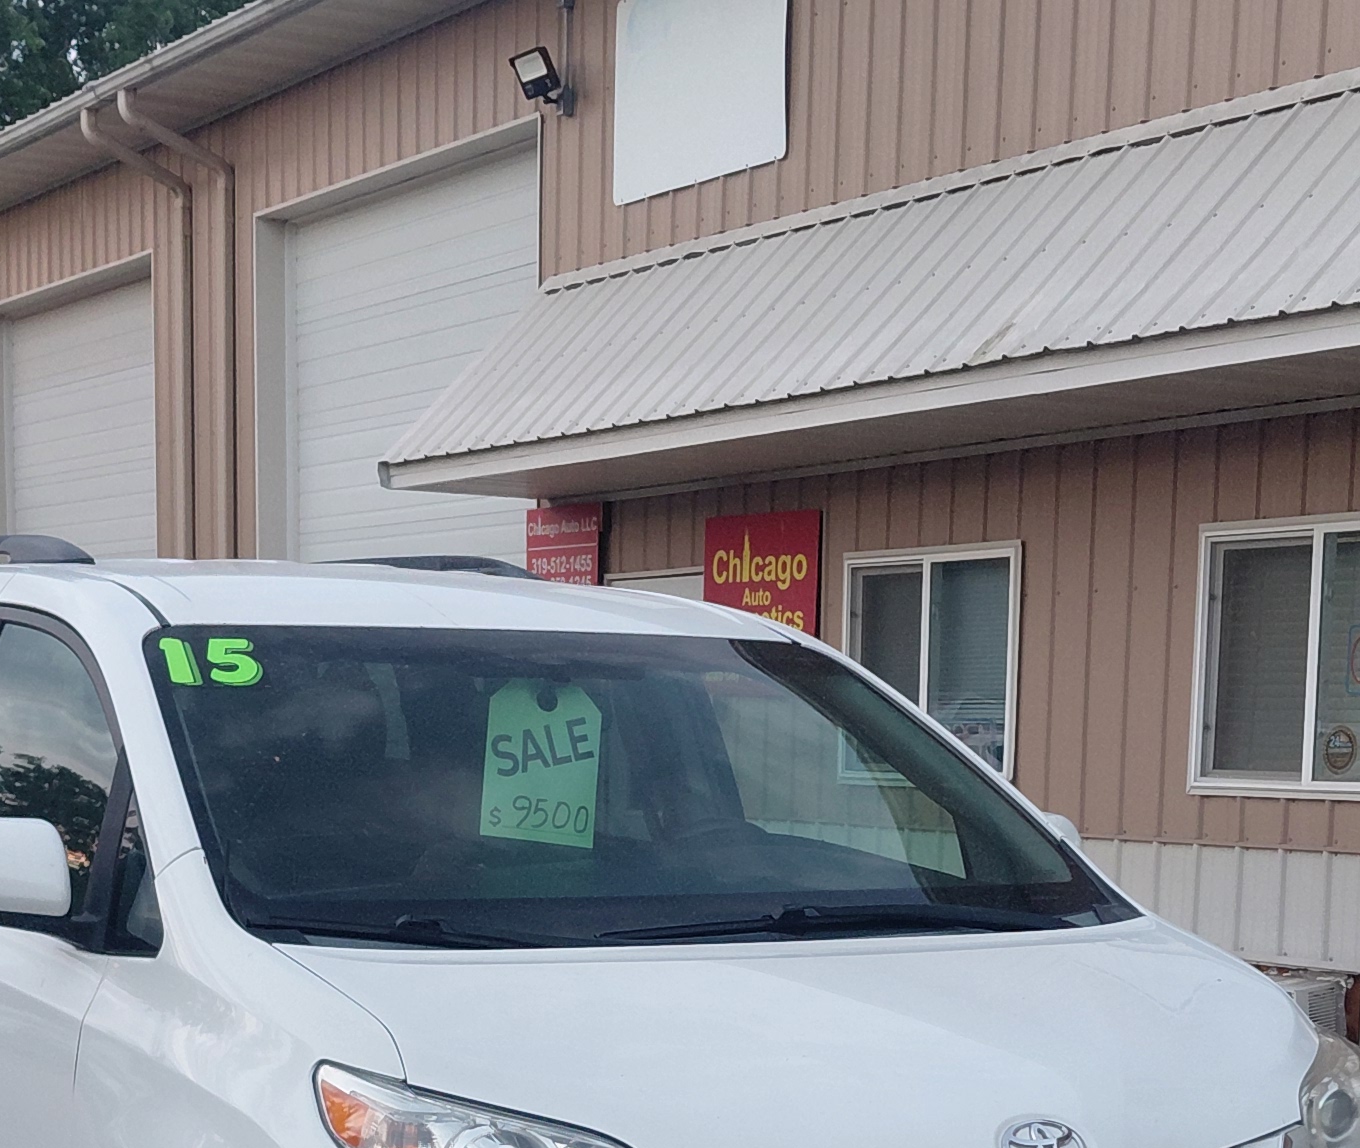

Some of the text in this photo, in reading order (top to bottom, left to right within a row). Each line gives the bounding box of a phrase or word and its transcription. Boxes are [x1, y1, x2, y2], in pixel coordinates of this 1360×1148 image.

[527, 515, 597, 538] Chicago Auto LLC
[531, 554, 593, 575] 319-512-1455
[712, 526, 808, 590] Chicago
[741, 587, 772, 607] Auto
[158, 637, 264, 686] 15
[491, 716, 595, 777] SALE
[512, 795, 590, 834] 9500
